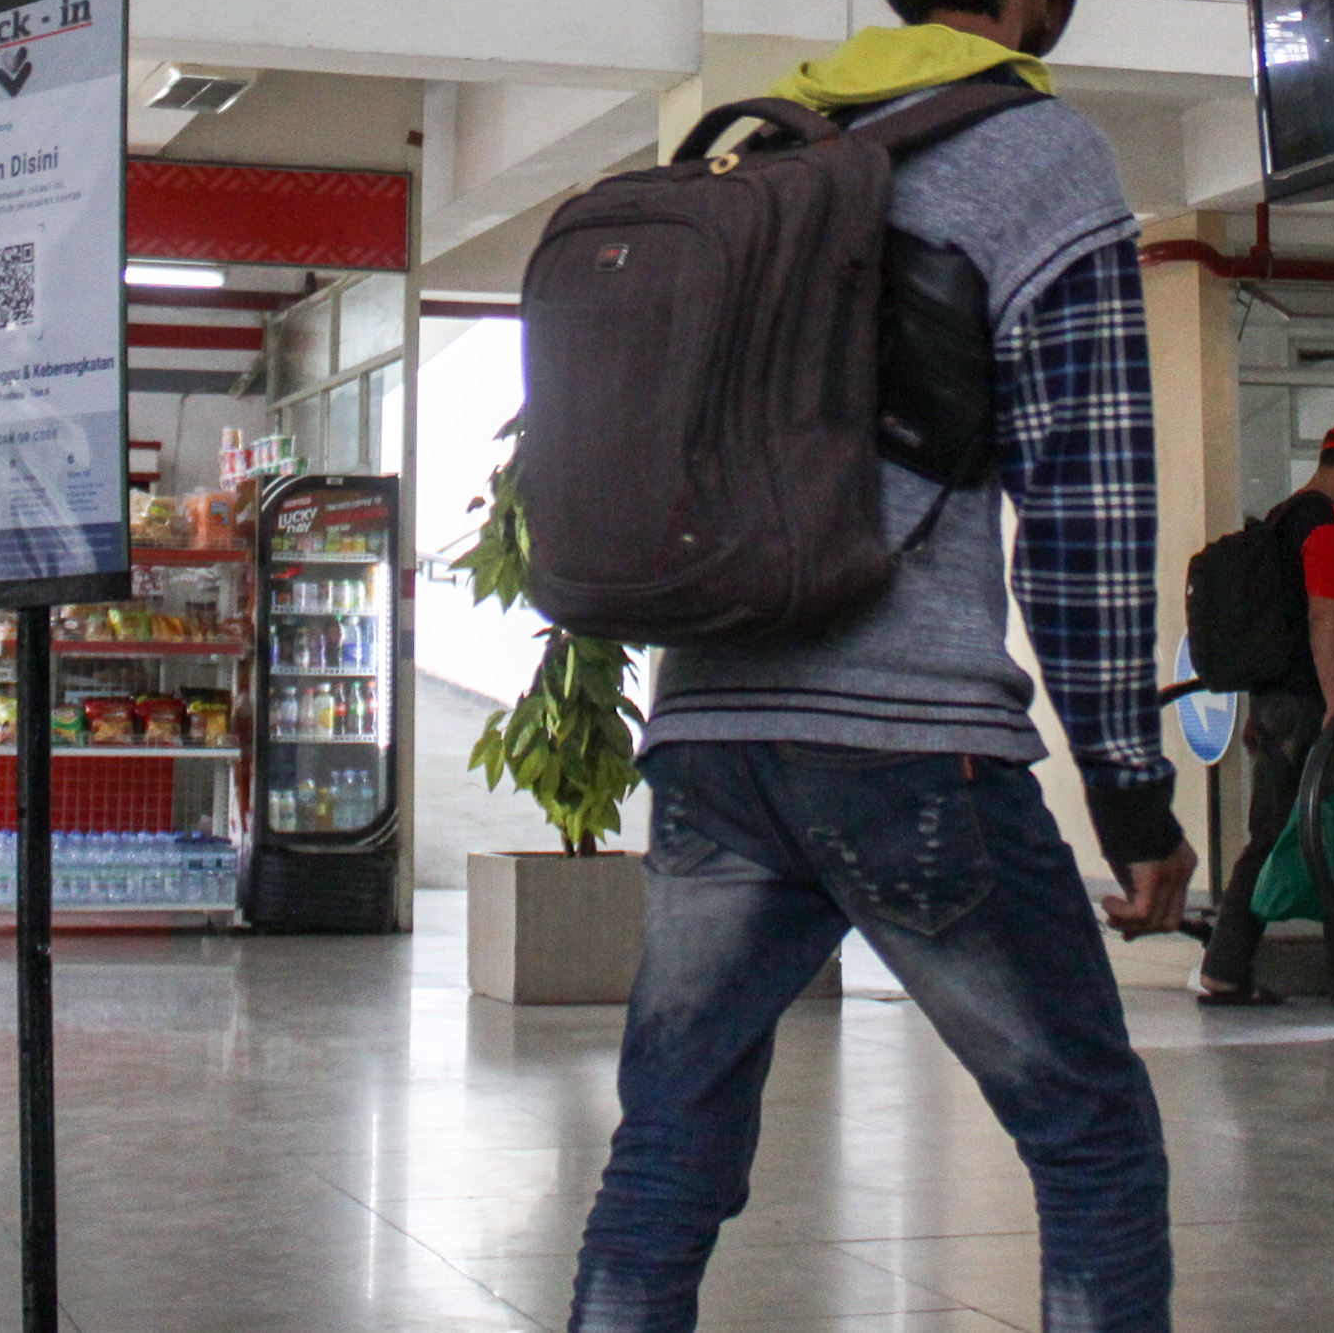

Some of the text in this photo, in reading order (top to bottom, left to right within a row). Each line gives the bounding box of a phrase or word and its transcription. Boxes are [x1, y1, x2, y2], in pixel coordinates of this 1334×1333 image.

[10, 146, 59, 178] Disini
[33, 357, 115, 377] Keberangkatan
[278, 506, 319, 530] LUCKY
